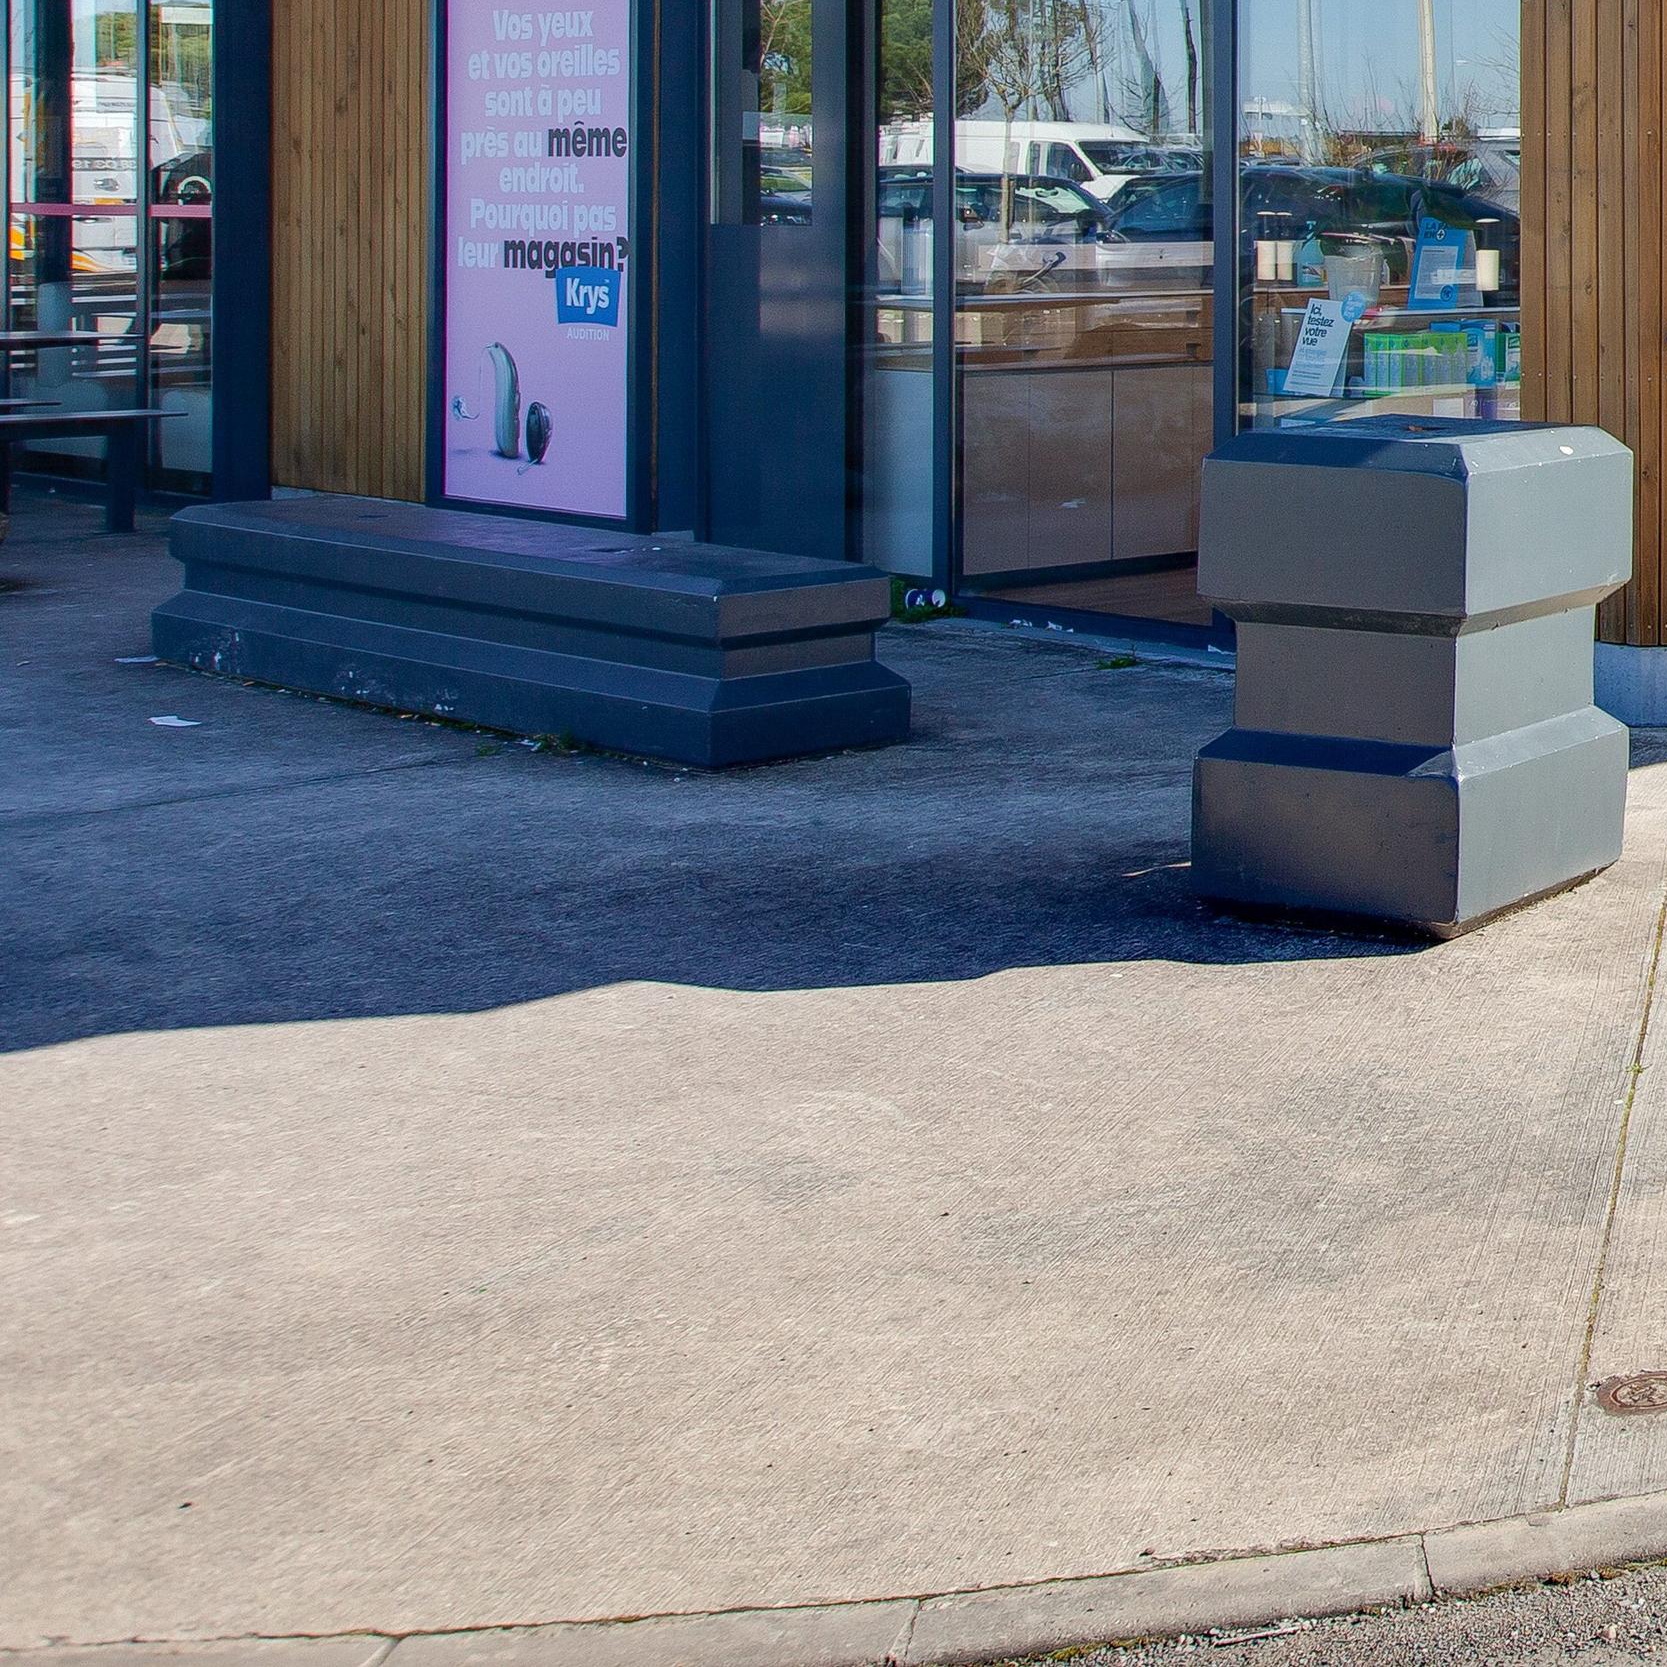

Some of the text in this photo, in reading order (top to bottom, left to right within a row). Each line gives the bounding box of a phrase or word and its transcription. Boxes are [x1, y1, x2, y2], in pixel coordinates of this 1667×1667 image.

[493, 9, 593, 46] Vos yeux
[468, 44, 620, 80] et vos oreilles
[484, 84, 601, 122] sont à peu
[460, 121, 628, 165] près au même
[499, 162, 585, 195] endroit.
[470, 198, 617, 239] Pourquoi pas
[457, 236, 629, 279] leur magasin?
[565, 277, 610, 315] Krys
[566, 327, 609, 342] AUDITION
